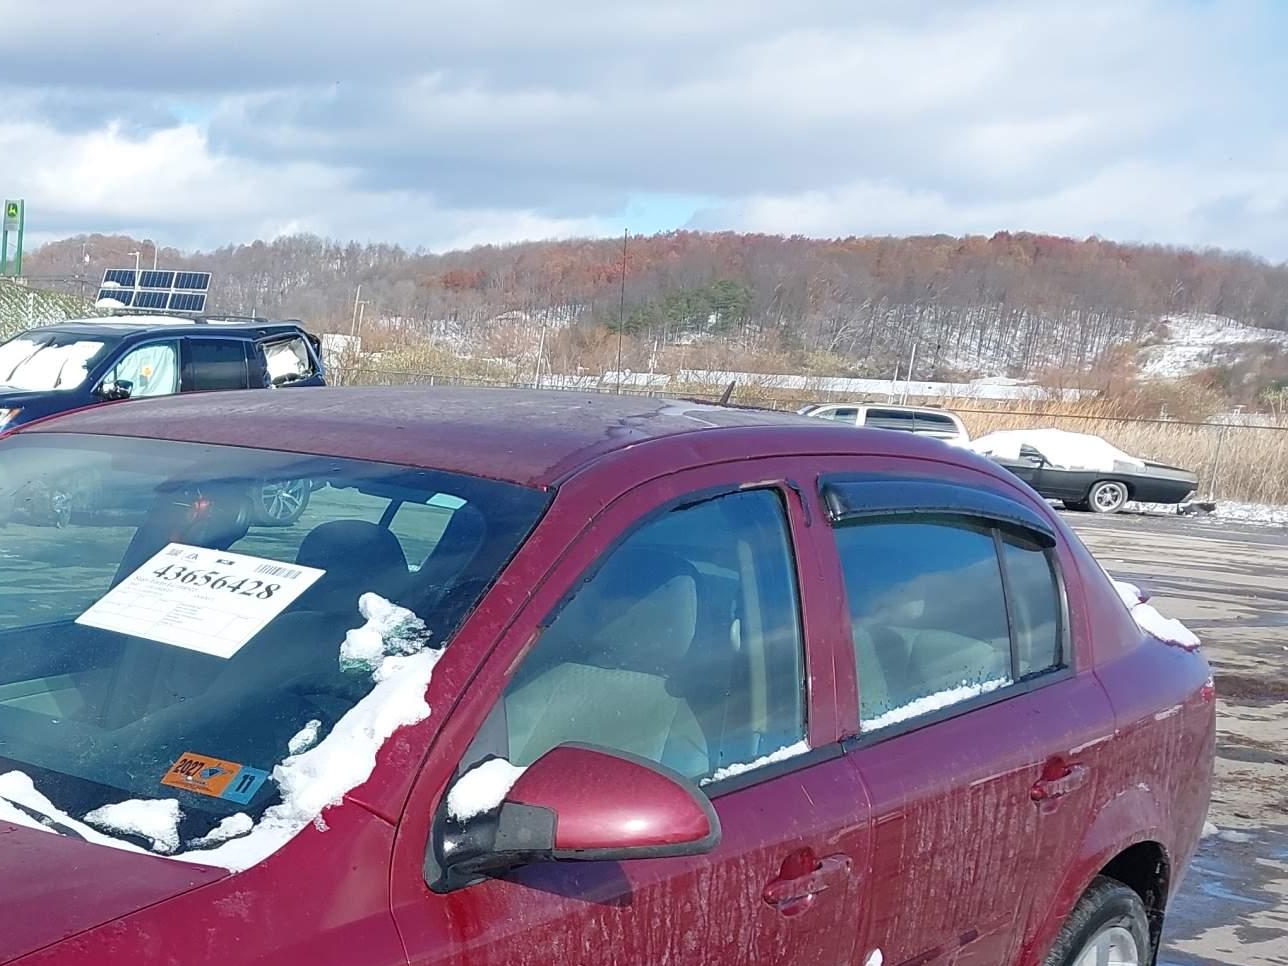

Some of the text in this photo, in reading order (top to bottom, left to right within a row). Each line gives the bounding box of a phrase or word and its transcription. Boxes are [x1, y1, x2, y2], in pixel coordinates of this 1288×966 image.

[153, 564, 281, 600] 43656428
[174, 759, 205, 777] 2027
[235, 774, 256, 793] 11
